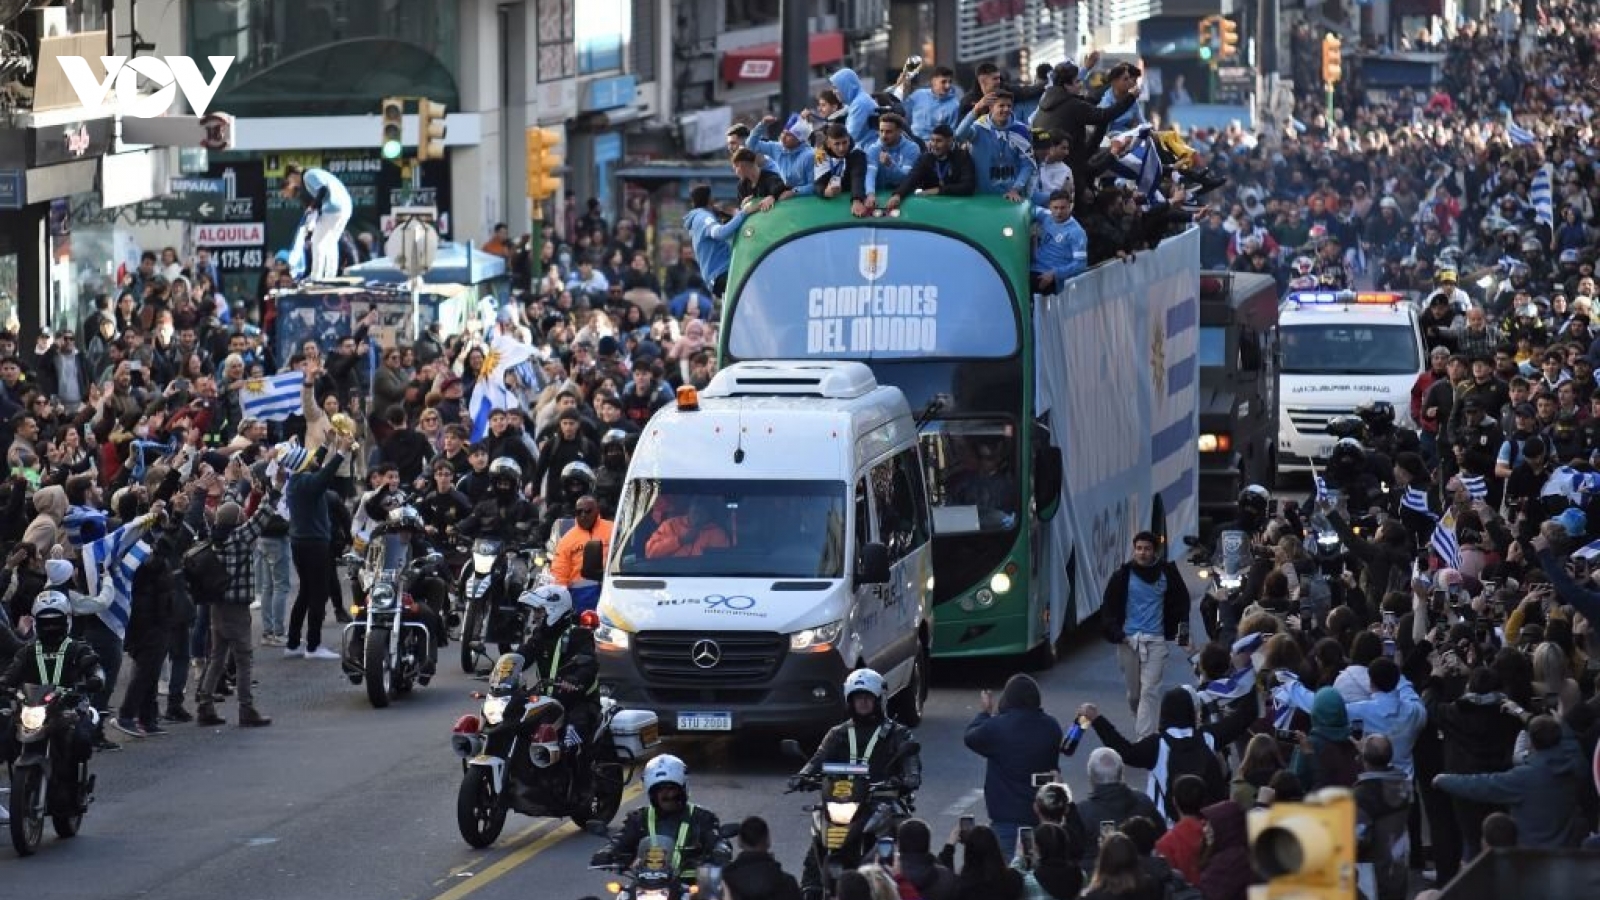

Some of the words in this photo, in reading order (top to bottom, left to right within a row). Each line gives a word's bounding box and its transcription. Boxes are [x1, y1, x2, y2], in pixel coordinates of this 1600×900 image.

[198, 226, 261, 241] ALQUILA
[221, 249, 241, 268] 175
[242, 249, 262, 267] 453
[808, 285, 939, 318] CAMPEONES
[807, 318, 847, 354] DEL
[850, 316, 937, 352] MUNDO
[703, 593, 756, 611] 90
[680, 717, 699, 729] STU
